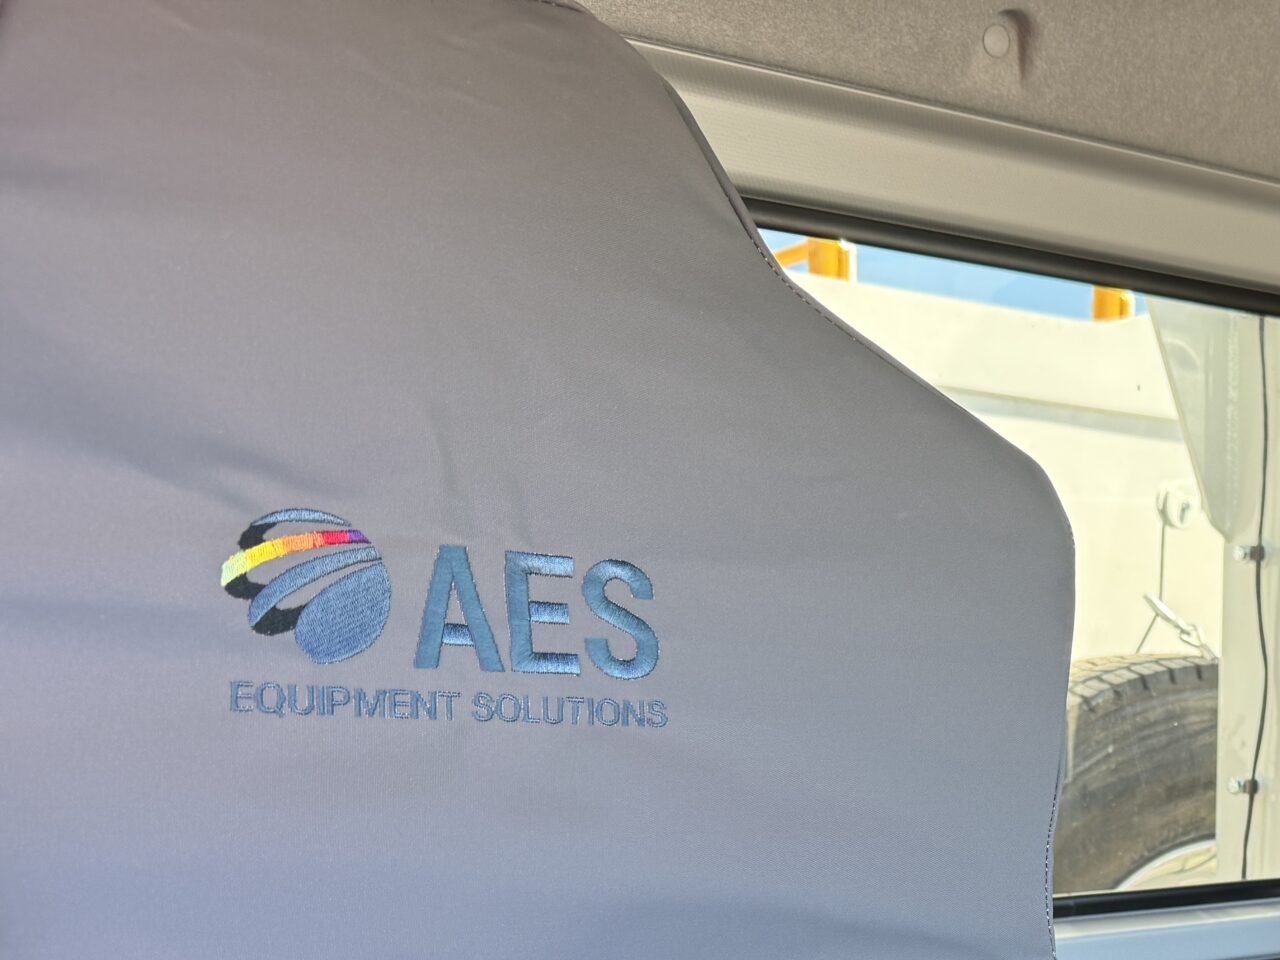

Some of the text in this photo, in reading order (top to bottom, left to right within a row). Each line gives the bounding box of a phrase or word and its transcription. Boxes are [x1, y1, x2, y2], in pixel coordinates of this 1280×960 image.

[413, 543, 659, 681] AES
[229, 680, 669, 729] EQUIPMENT SOLUTIONS
